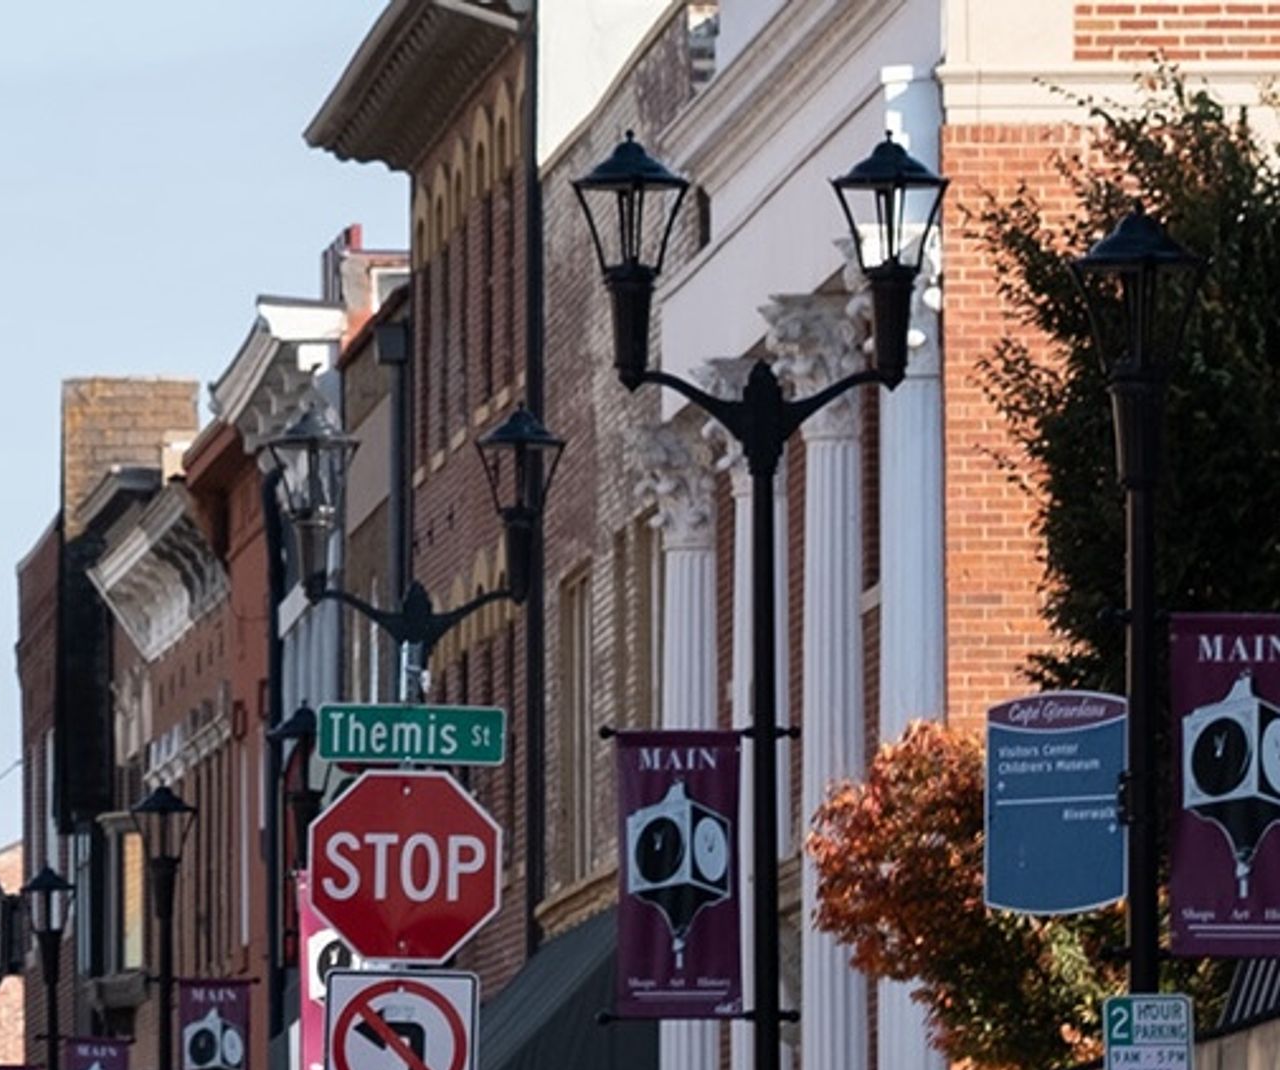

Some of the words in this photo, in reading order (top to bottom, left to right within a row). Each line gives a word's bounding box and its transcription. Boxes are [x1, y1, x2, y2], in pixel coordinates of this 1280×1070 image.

[1198, 633, 1280, 662] MAIN
[328, 711, 459, 755] Themis
[471, 724, 491, 747] St
[639, 747, 719, 771] MAIN
[997, 745, 1040, 759] Visitors
[1041, 742, 1080, 756] Center
[997, 759, 1053, 775] Children's
[1055, 758, 1101, 772] Museum
[321, 831, 487, 902] STOP
[1230, 907, 1251, 921] Art
[191, 988, 237, 1001] MAIN
[1110, 1005, 1130, 1039] 2
[1137, 1003, 1183, 1020] HOUR
[1134, 1023, 1187, 1040] PARKING
[77, 1044, 118, 1058] MAIN
